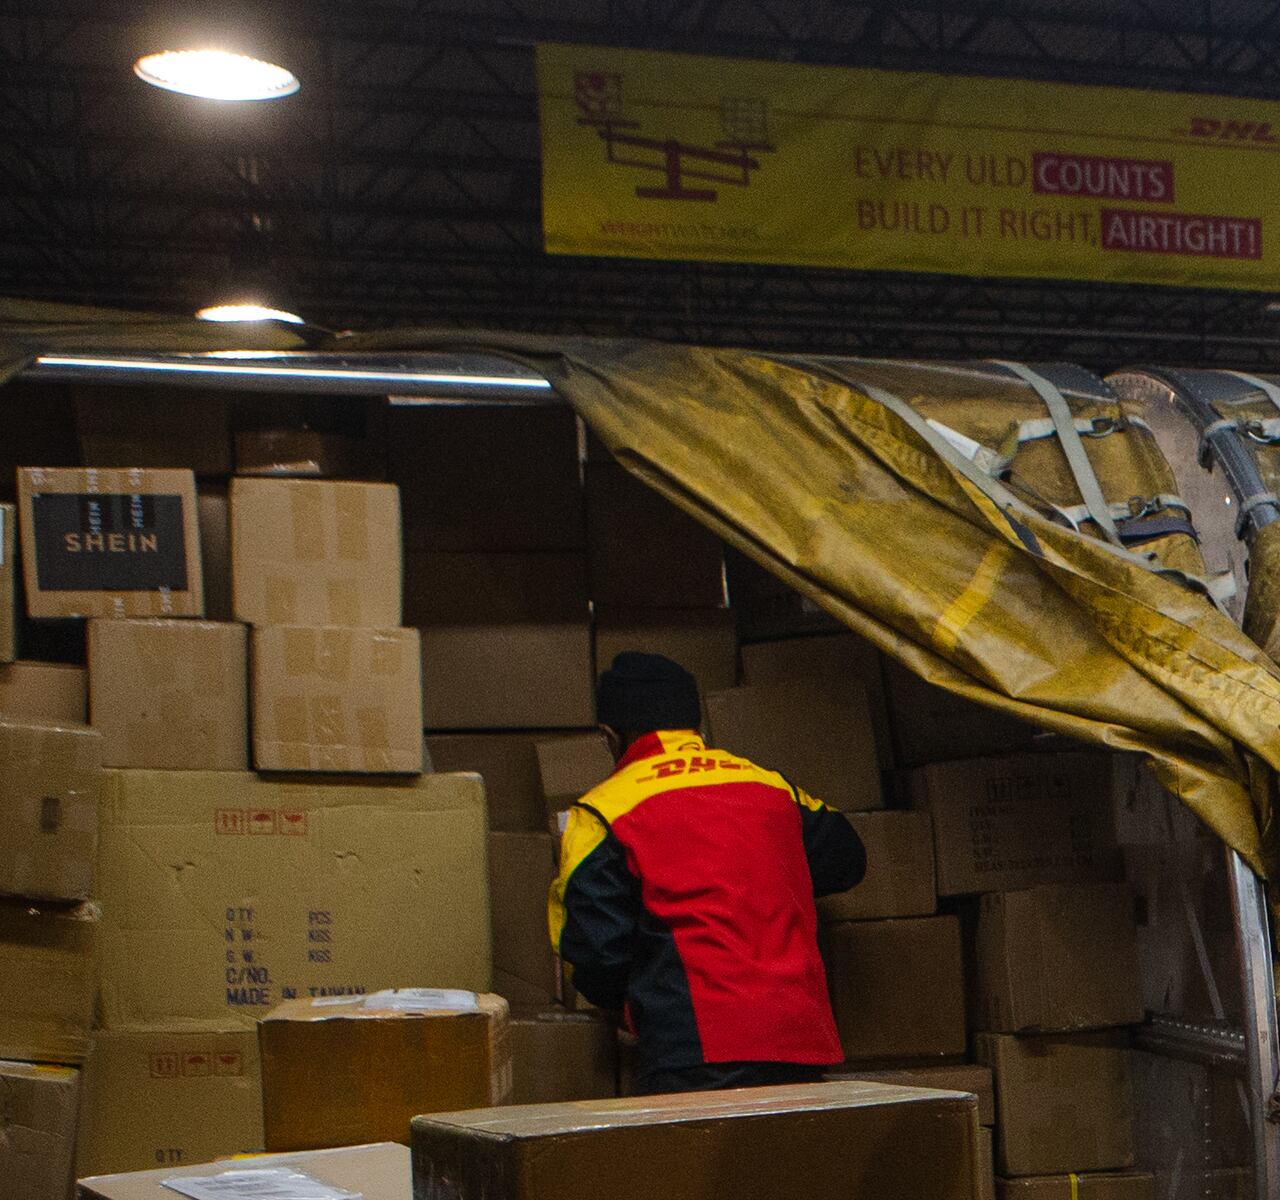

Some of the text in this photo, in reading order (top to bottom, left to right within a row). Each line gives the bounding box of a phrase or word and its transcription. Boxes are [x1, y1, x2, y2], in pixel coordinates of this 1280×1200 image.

[853, 144, 1166, 199] EVERY ULD COUNTS
[857, 198, 950, 234] BUILD
[960, 207, 985, 240] IT
[1106, 214, 1256, 255] AIRTIGHT!
[64, 532, 158, 552] SHEIN
[227, 988, 270, 1005] MADE
[282, 987, 296, 999] IN
